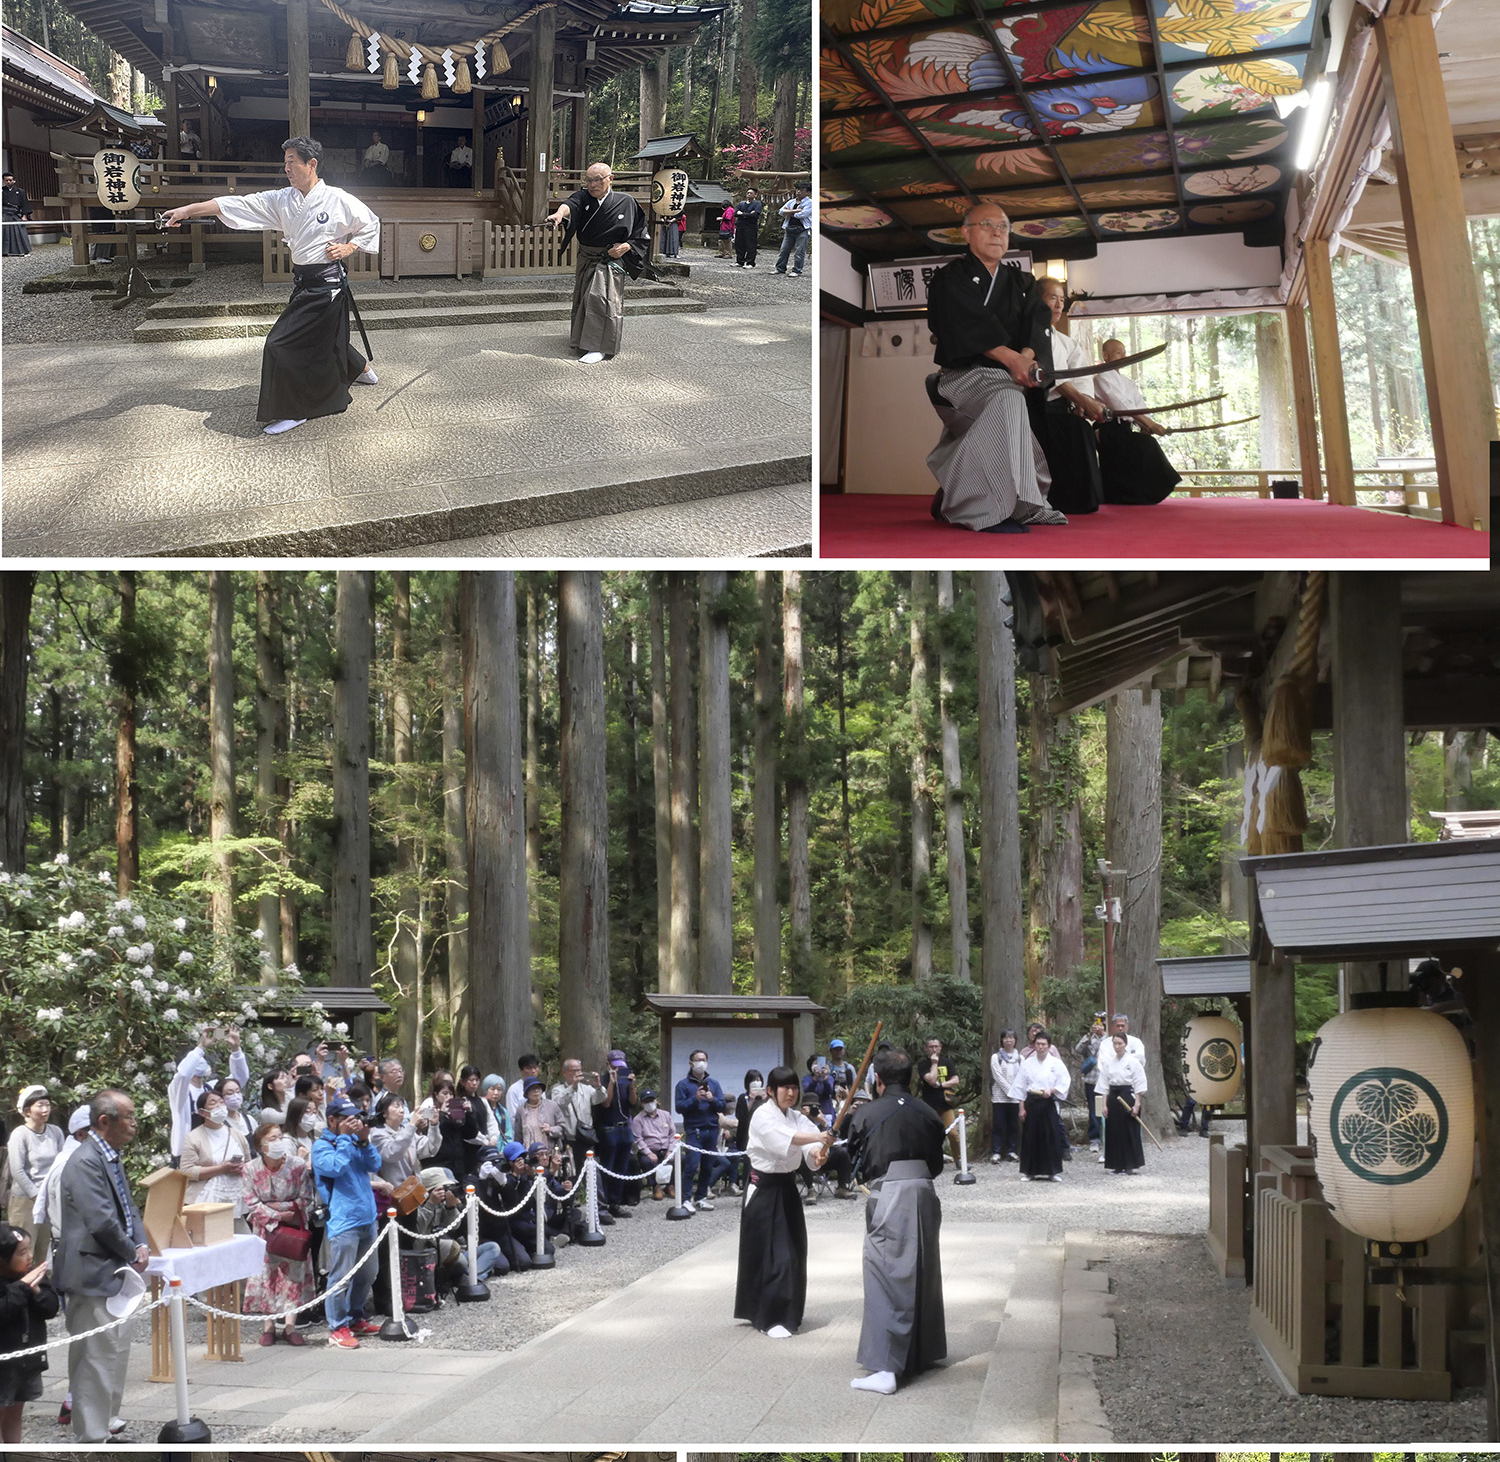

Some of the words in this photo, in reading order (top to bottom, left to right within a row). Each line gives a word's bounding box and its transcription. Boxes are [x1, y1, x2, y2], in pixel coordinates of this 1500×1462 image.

[101, 152, 128, 204] 御岩神社
[669, 172, 686, 211] 御岩神社
